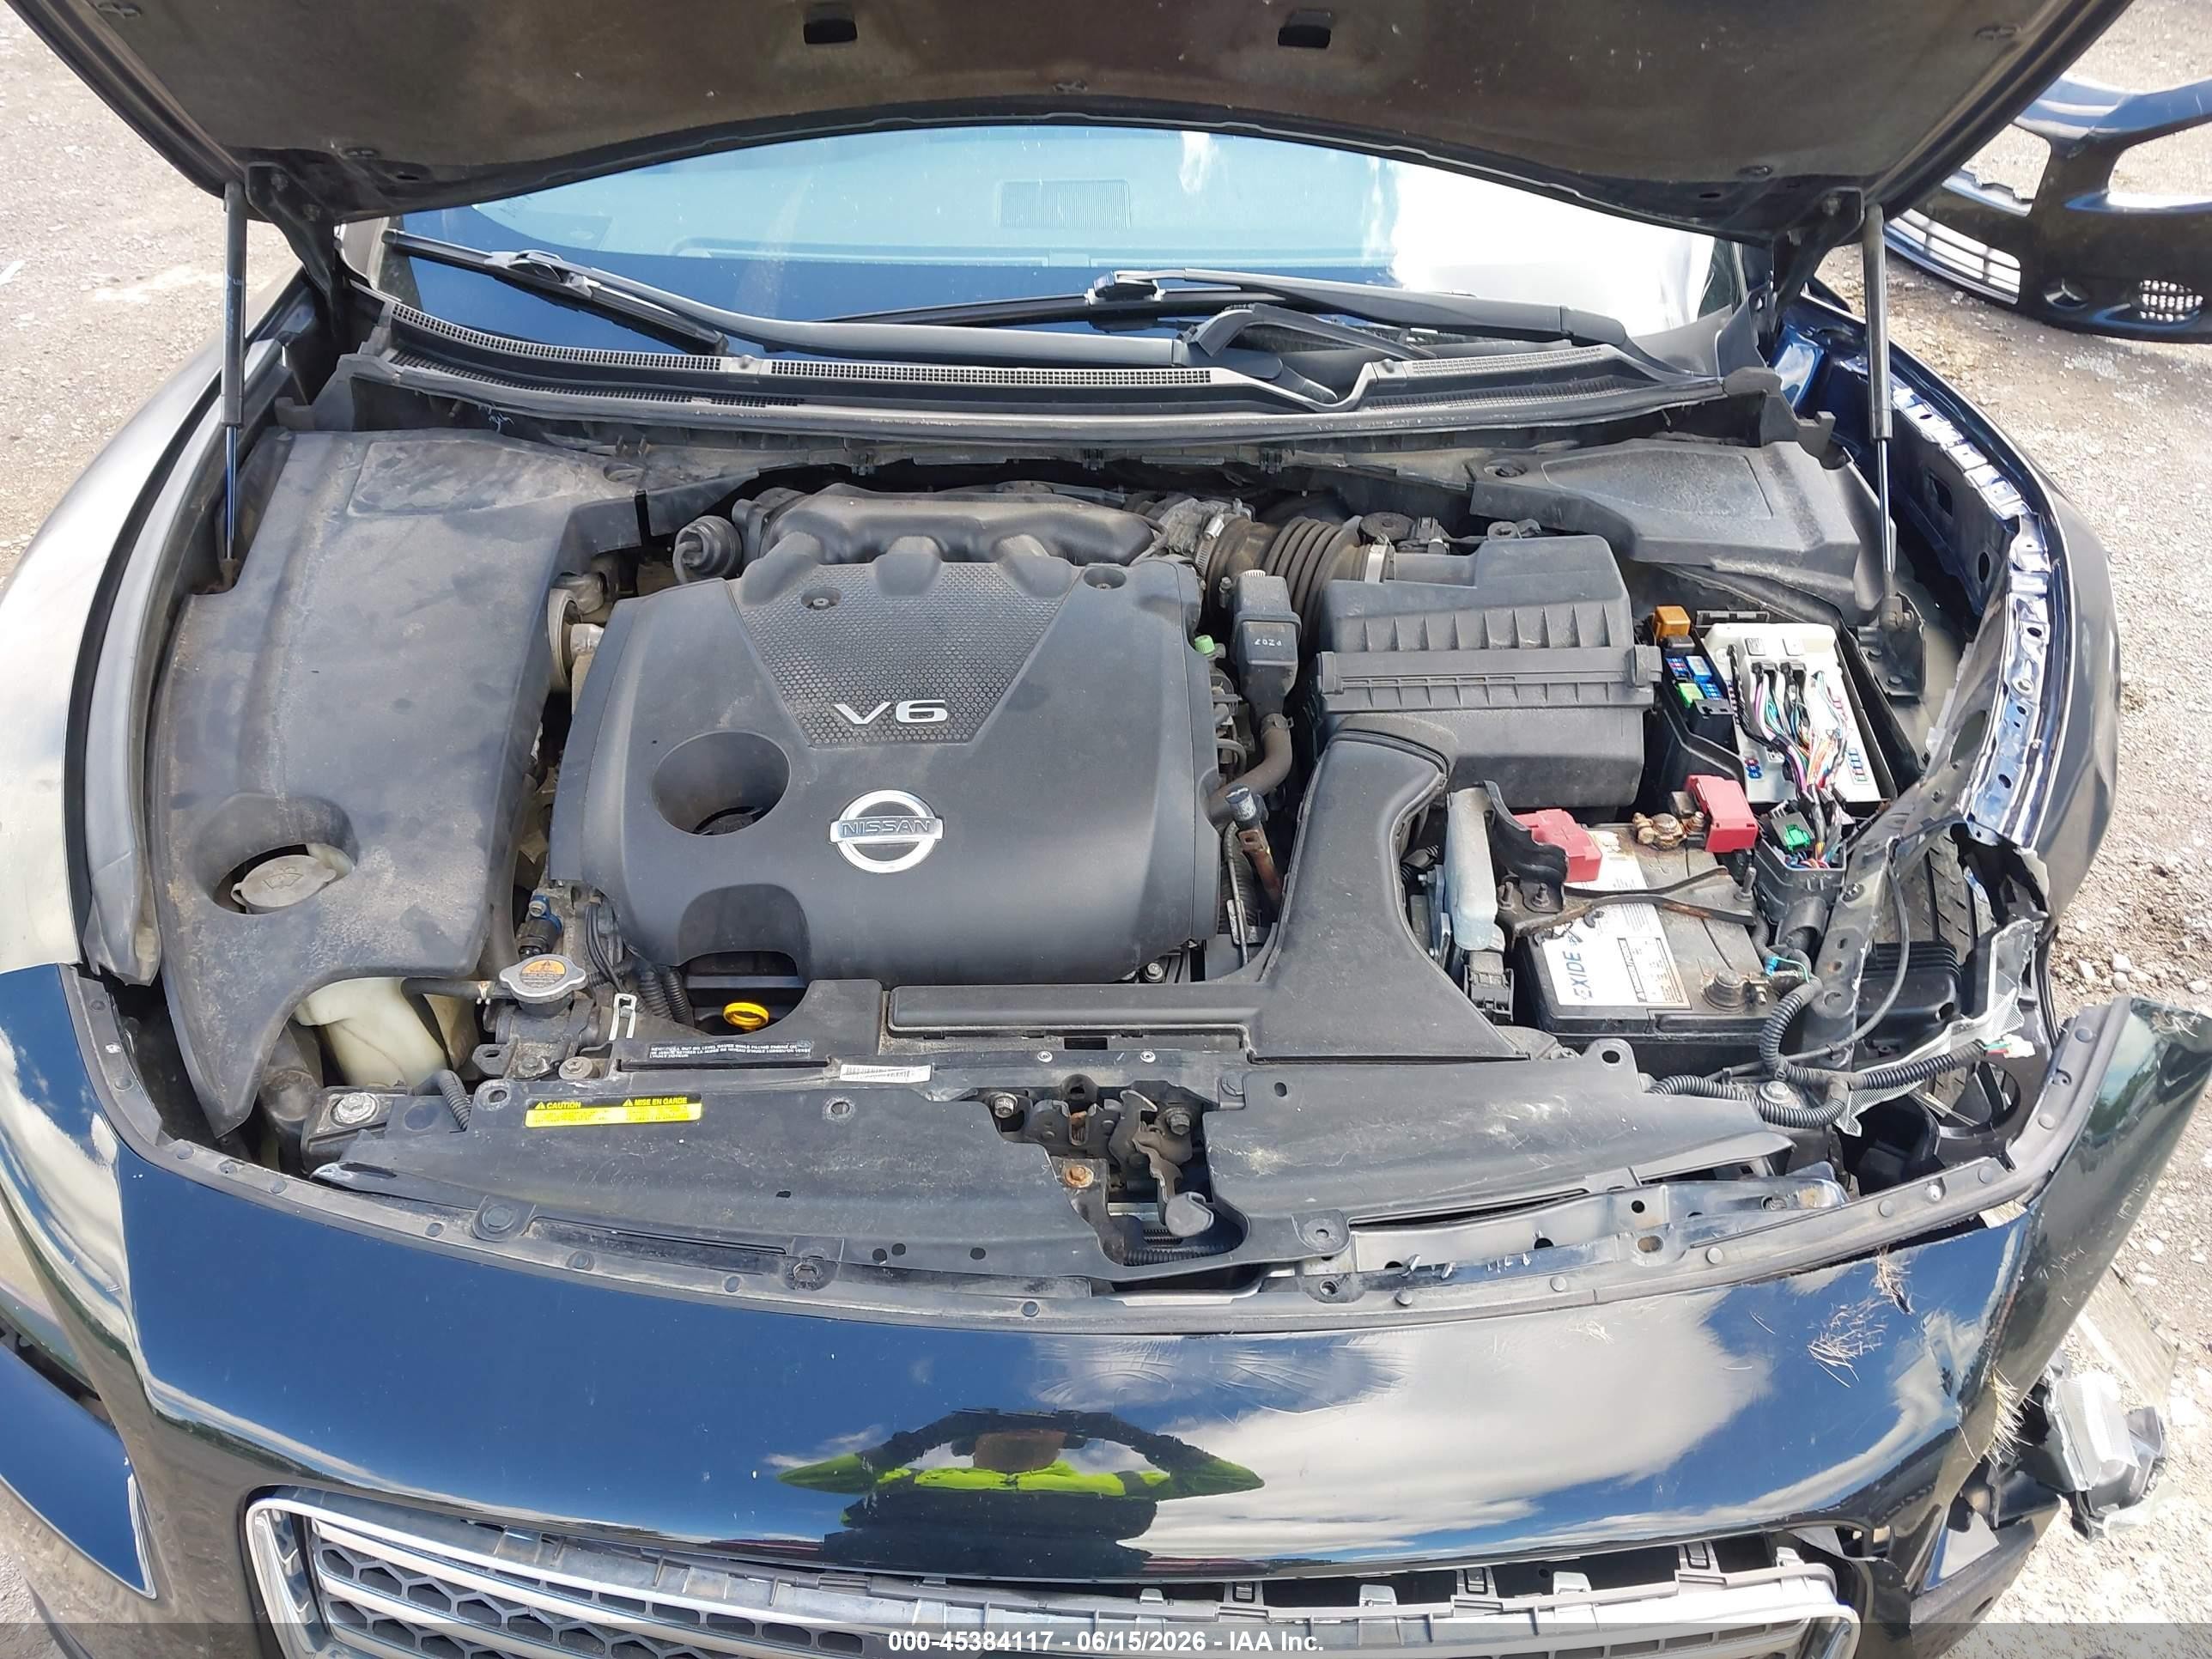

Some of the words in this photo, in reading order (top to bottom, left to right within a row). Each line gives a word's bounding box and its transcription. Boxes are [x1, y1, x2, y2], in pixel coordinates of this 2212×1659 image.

[833, 700, 948, 725] V6
[842, 820, 931, 837] NISSAN
[1562, 950, 1593, 1000] EXIDE
[546, 1101, 581, 1109] CAUTION
[663, 1097, 687, 1105] GARDE
